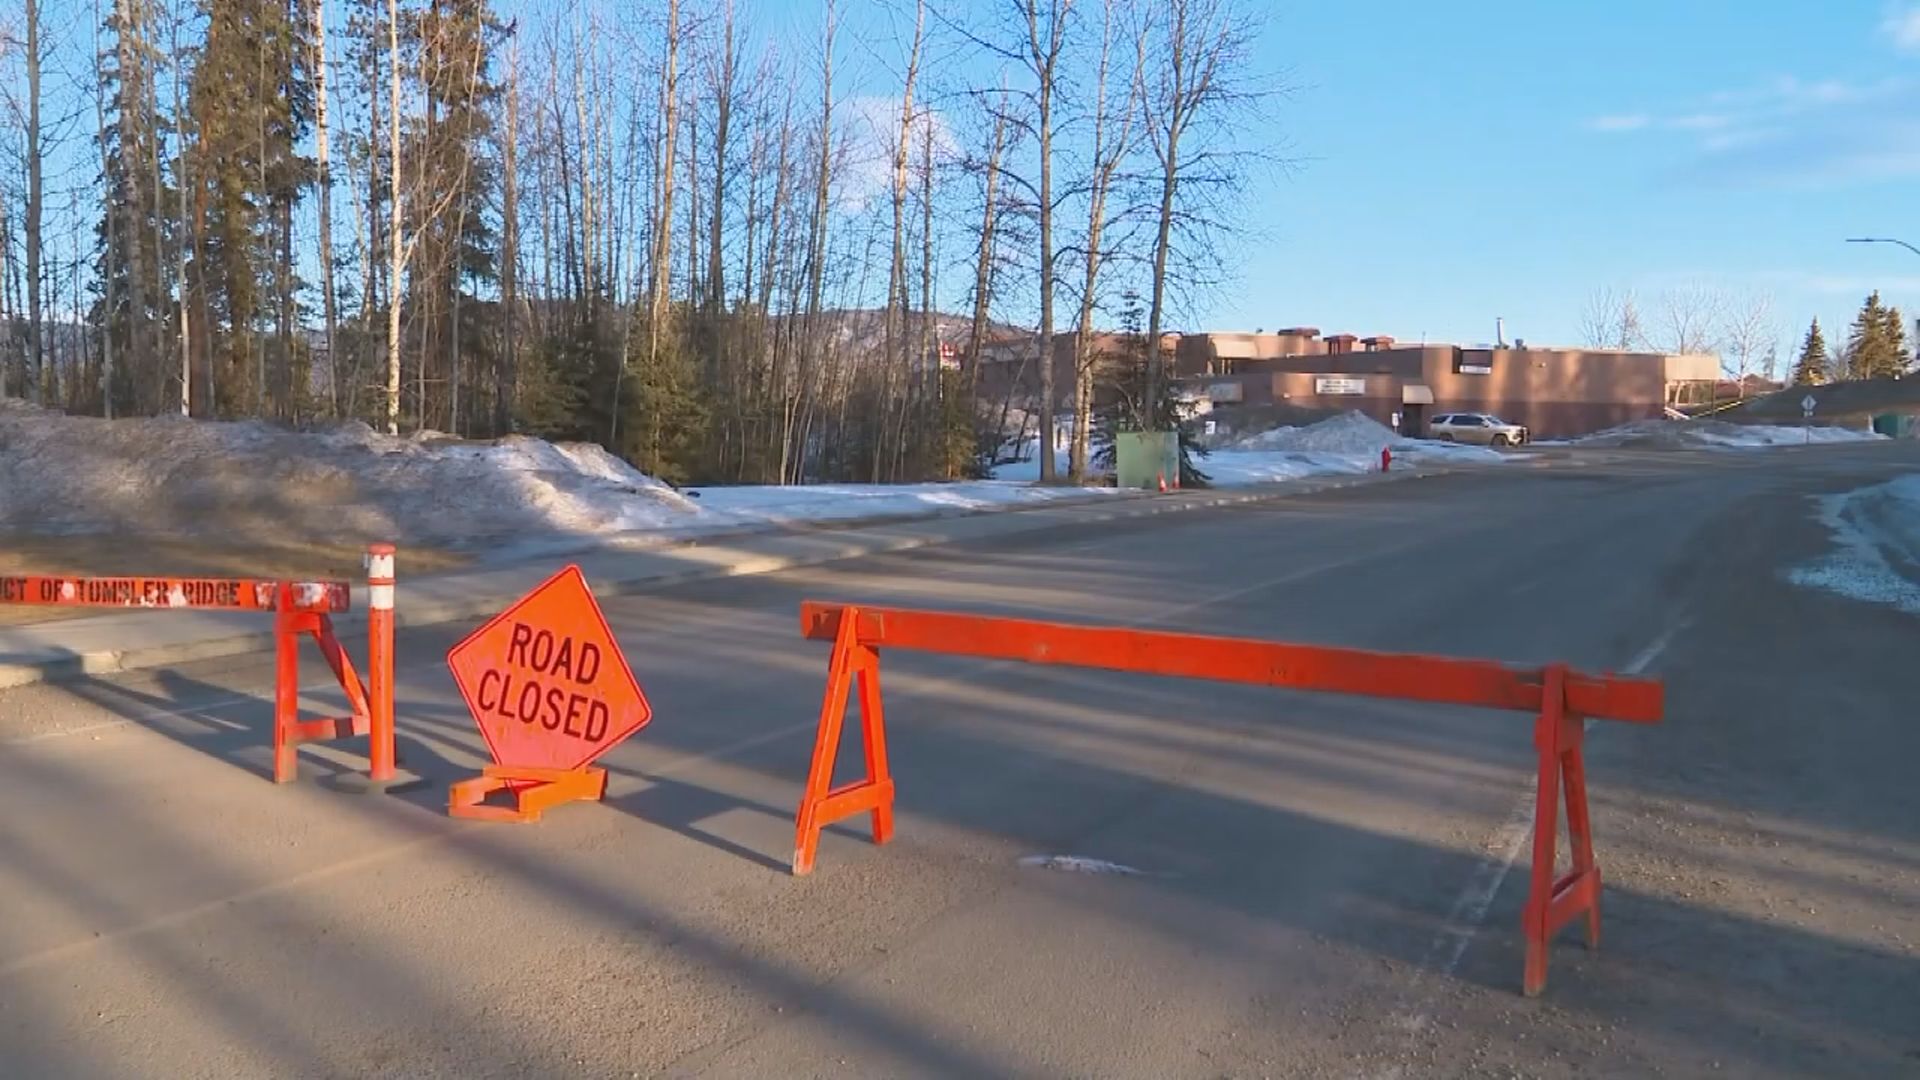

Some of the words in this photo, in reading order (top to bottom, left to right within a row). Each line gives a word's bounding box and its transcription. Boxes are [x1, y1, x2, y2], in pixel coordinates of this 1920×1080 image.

[40, 579, 64, 602] OF
[77, 579, 169, 605] TUMBLER
[182, 581, 240, 605] RIDGE
[507, 622, 600, 685] ROAD
[478, 669, 609, 743] CLOSED
